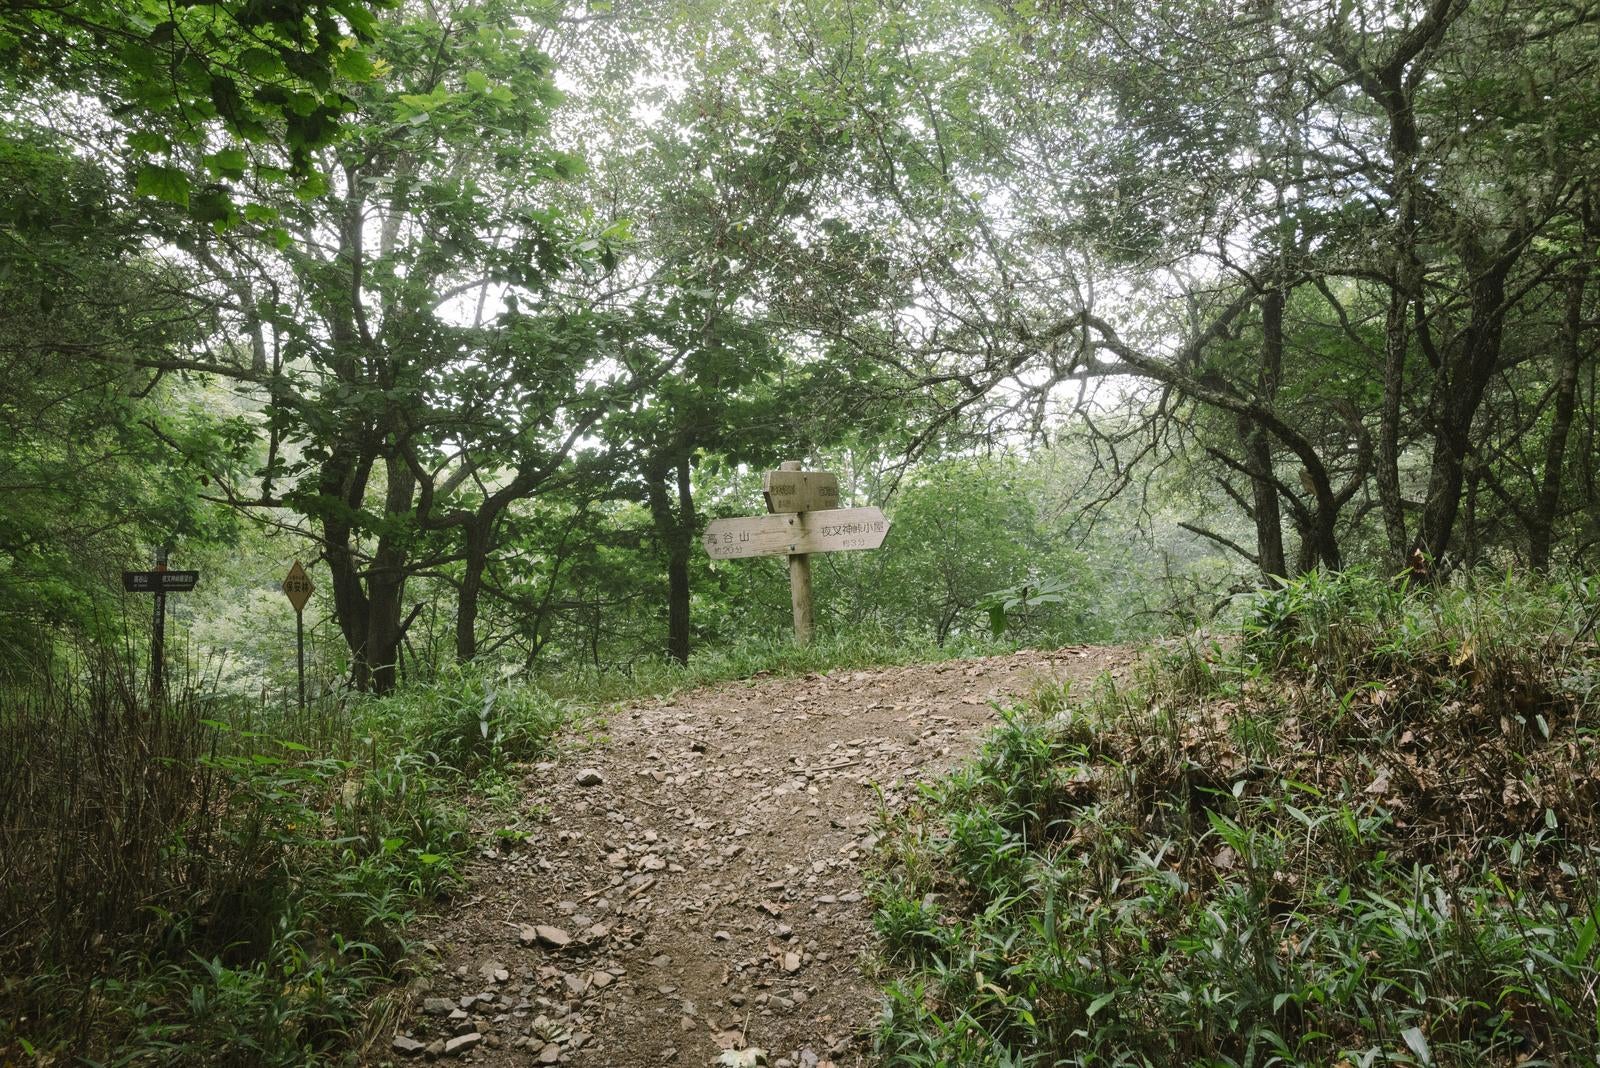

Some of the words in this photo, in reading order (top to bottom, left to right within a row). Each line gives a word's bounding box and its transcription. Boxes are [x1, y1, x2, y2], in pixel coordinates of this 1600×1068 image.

[821, 521, 884, 537] 夜叉神峠小屋
[707, 530, 750, 545] 高谷山
[714, 545, 743, 555] 約20分
